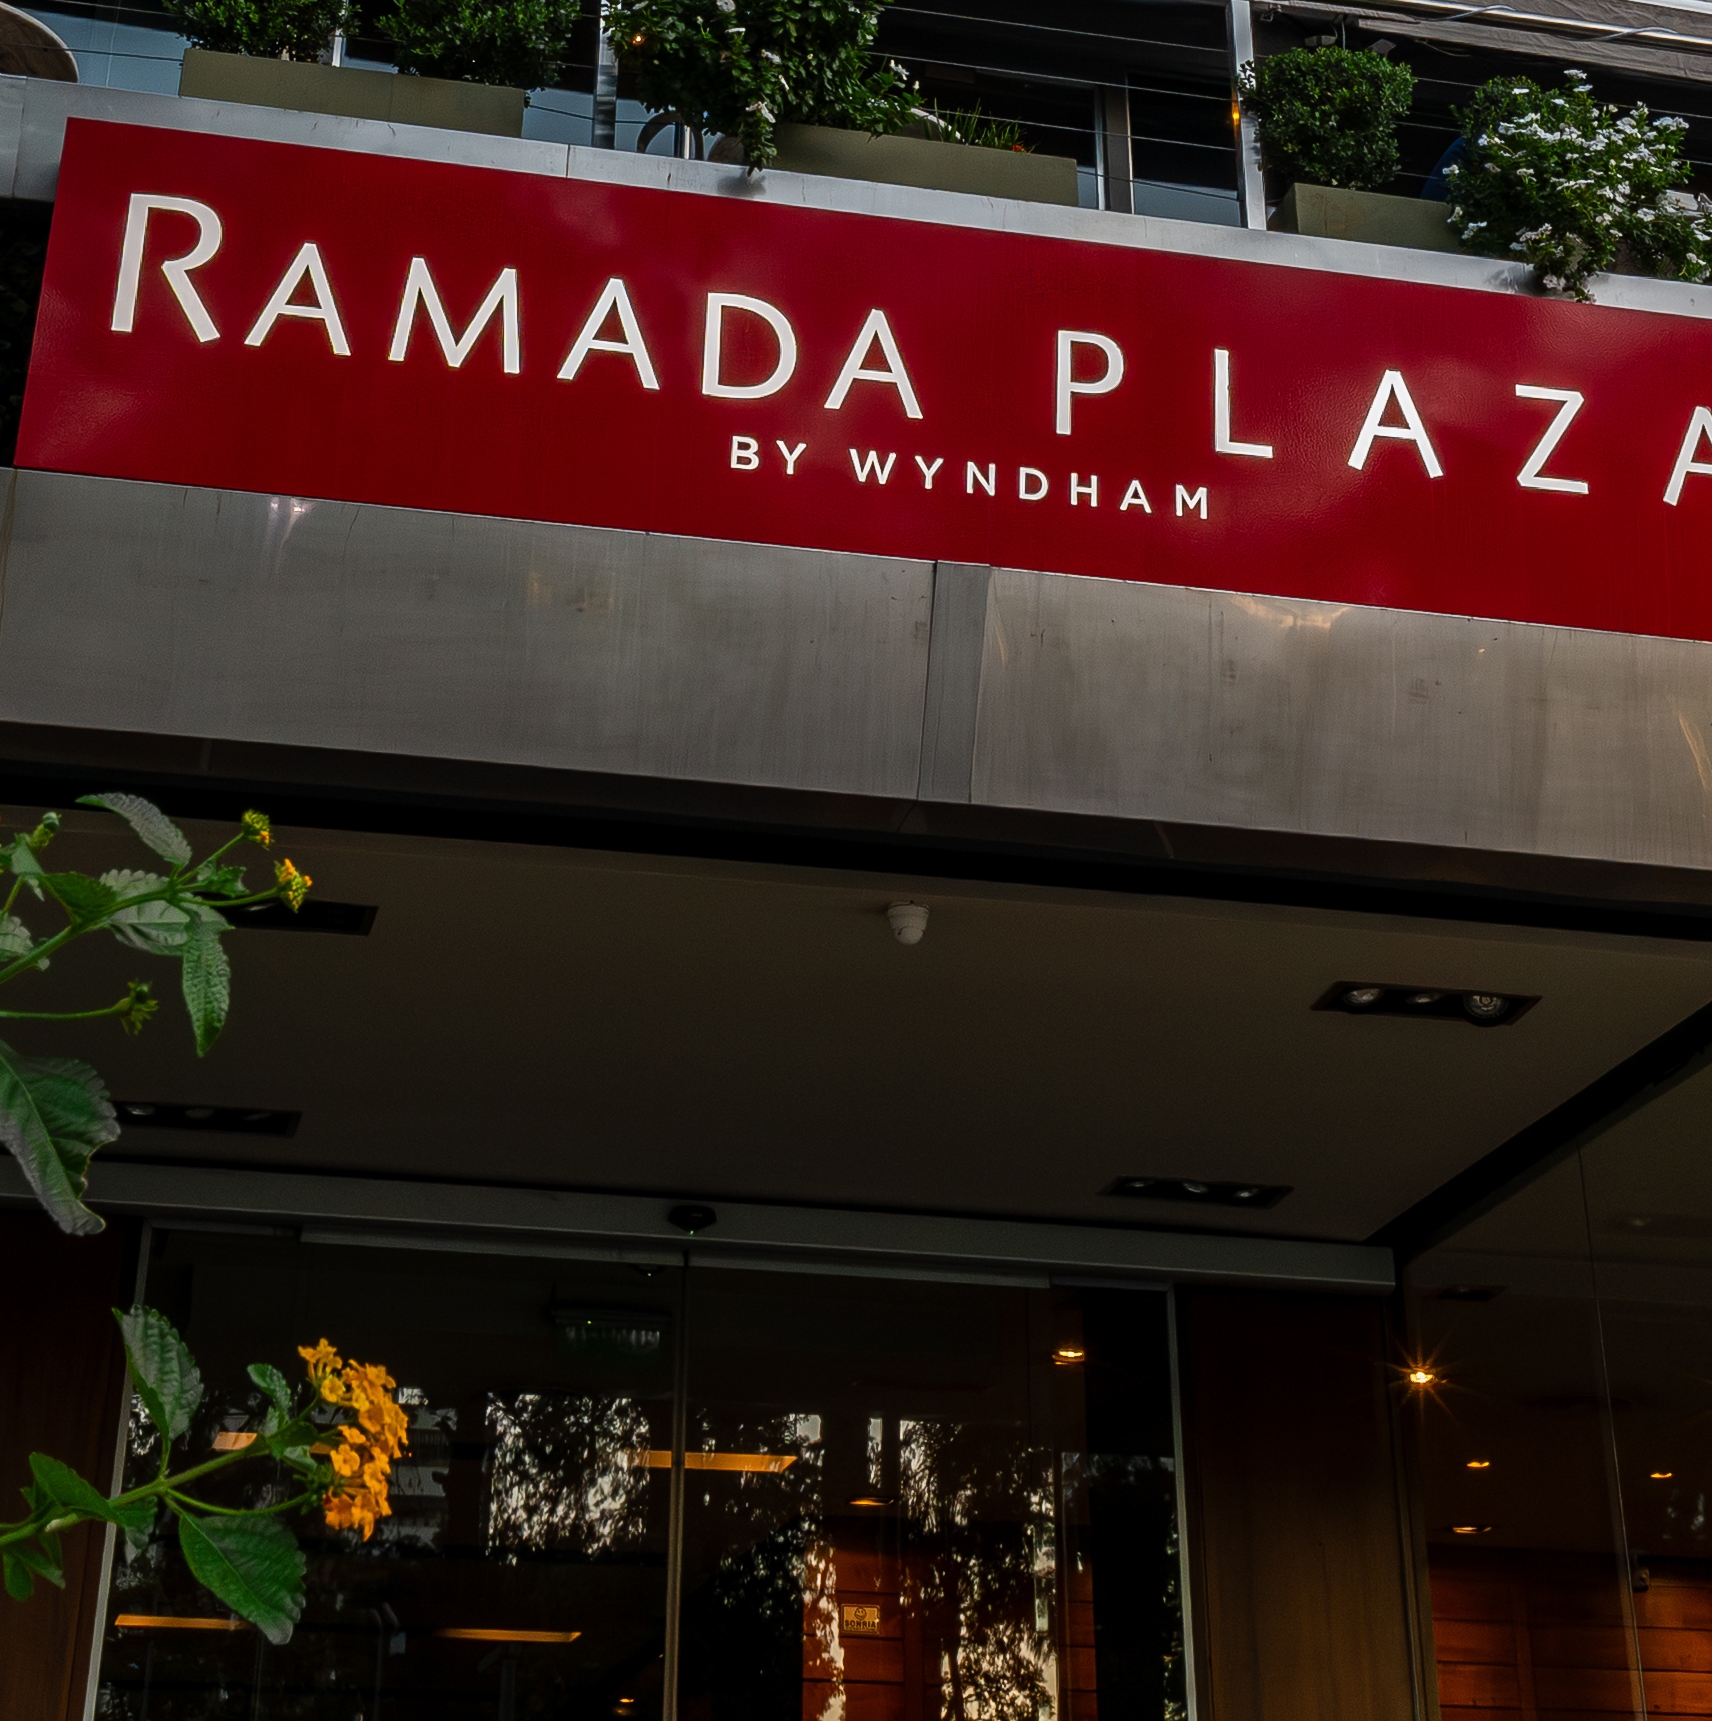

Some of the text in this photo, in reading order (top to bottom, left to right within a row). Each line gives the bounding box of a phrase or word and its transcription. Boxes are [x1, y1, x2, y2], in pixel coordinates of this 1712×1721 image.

[110, 192, 925, 420] RAMADA
[730, 435, 1208, 520] BY WYNDHAM
